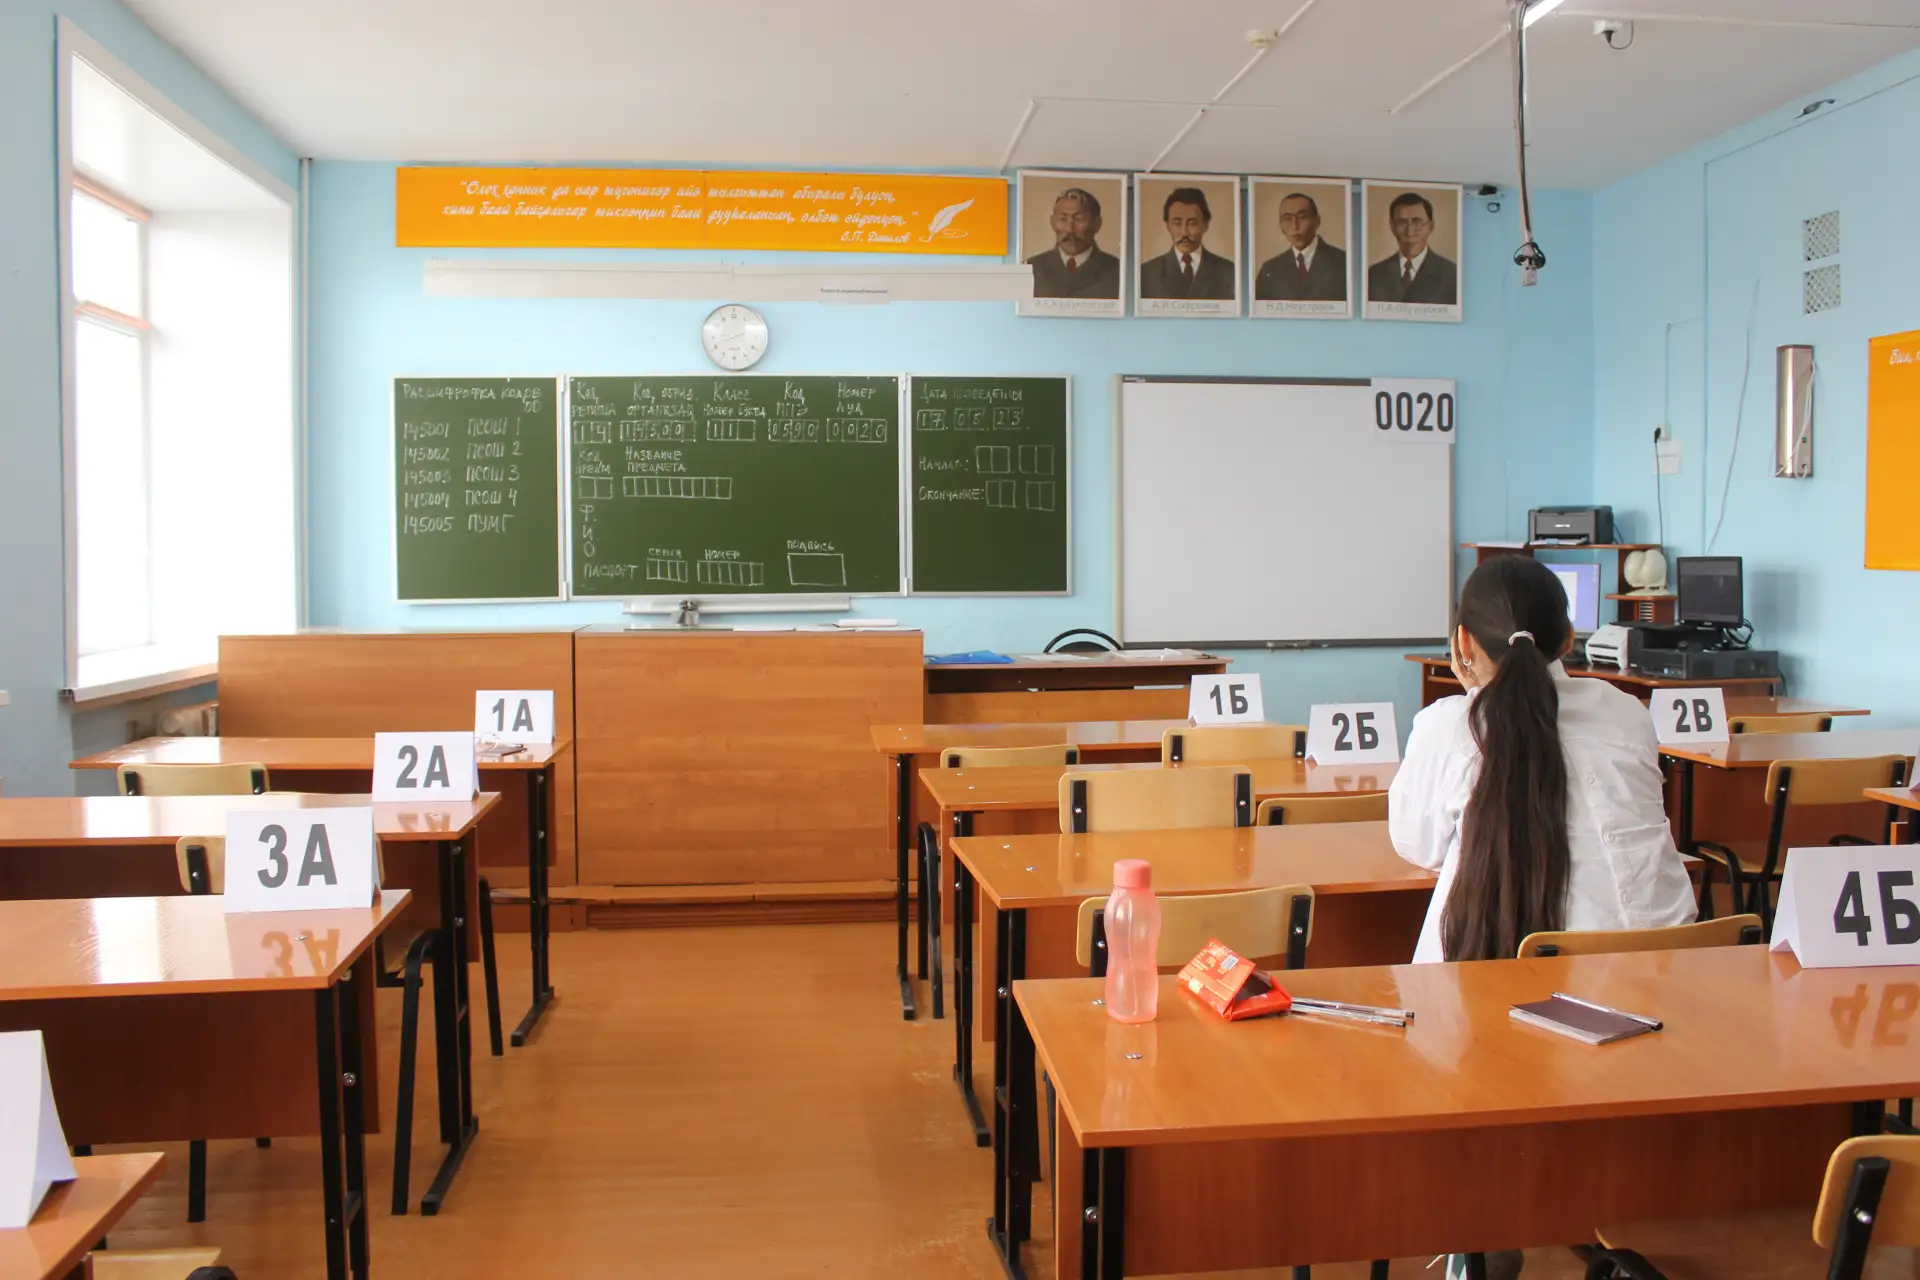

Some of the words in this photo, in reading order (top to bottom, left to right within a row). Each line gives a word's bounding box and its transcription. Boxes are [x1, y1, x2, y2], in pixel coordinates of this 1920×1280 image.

[403, 422, 450, 439] 145001
[467, 417, 508, 437] ПСОШ
[515, 417, 521, 436] 1
[1375, 391, 1454, 431] 0020
[403, 445, 451, 465] 145002
[466, 443, 505, 460] ПСОШ
[512, 441, 524, 456] 2
[465, 465, 505, 482] ПСОШ
[507, 464, 520, 481] 3
[403, 491, 450, 508] 145004
[465, 489, 502, 505] ПСОШ
[508, 488, 518, 506] 4
[403, 515, 455, 535] 145005
[492, 698, 534, 732] 1А
[1208, 682, 1250, 715] 1Б
[1331, 711, 1380, 752] 2Б
[1671, 698, 1714, 734] 2В
[396, 745, 451, 789] 2А
[257, 823, 338, 889] 3А
[1833, 870, 1920, 946] 4Б
